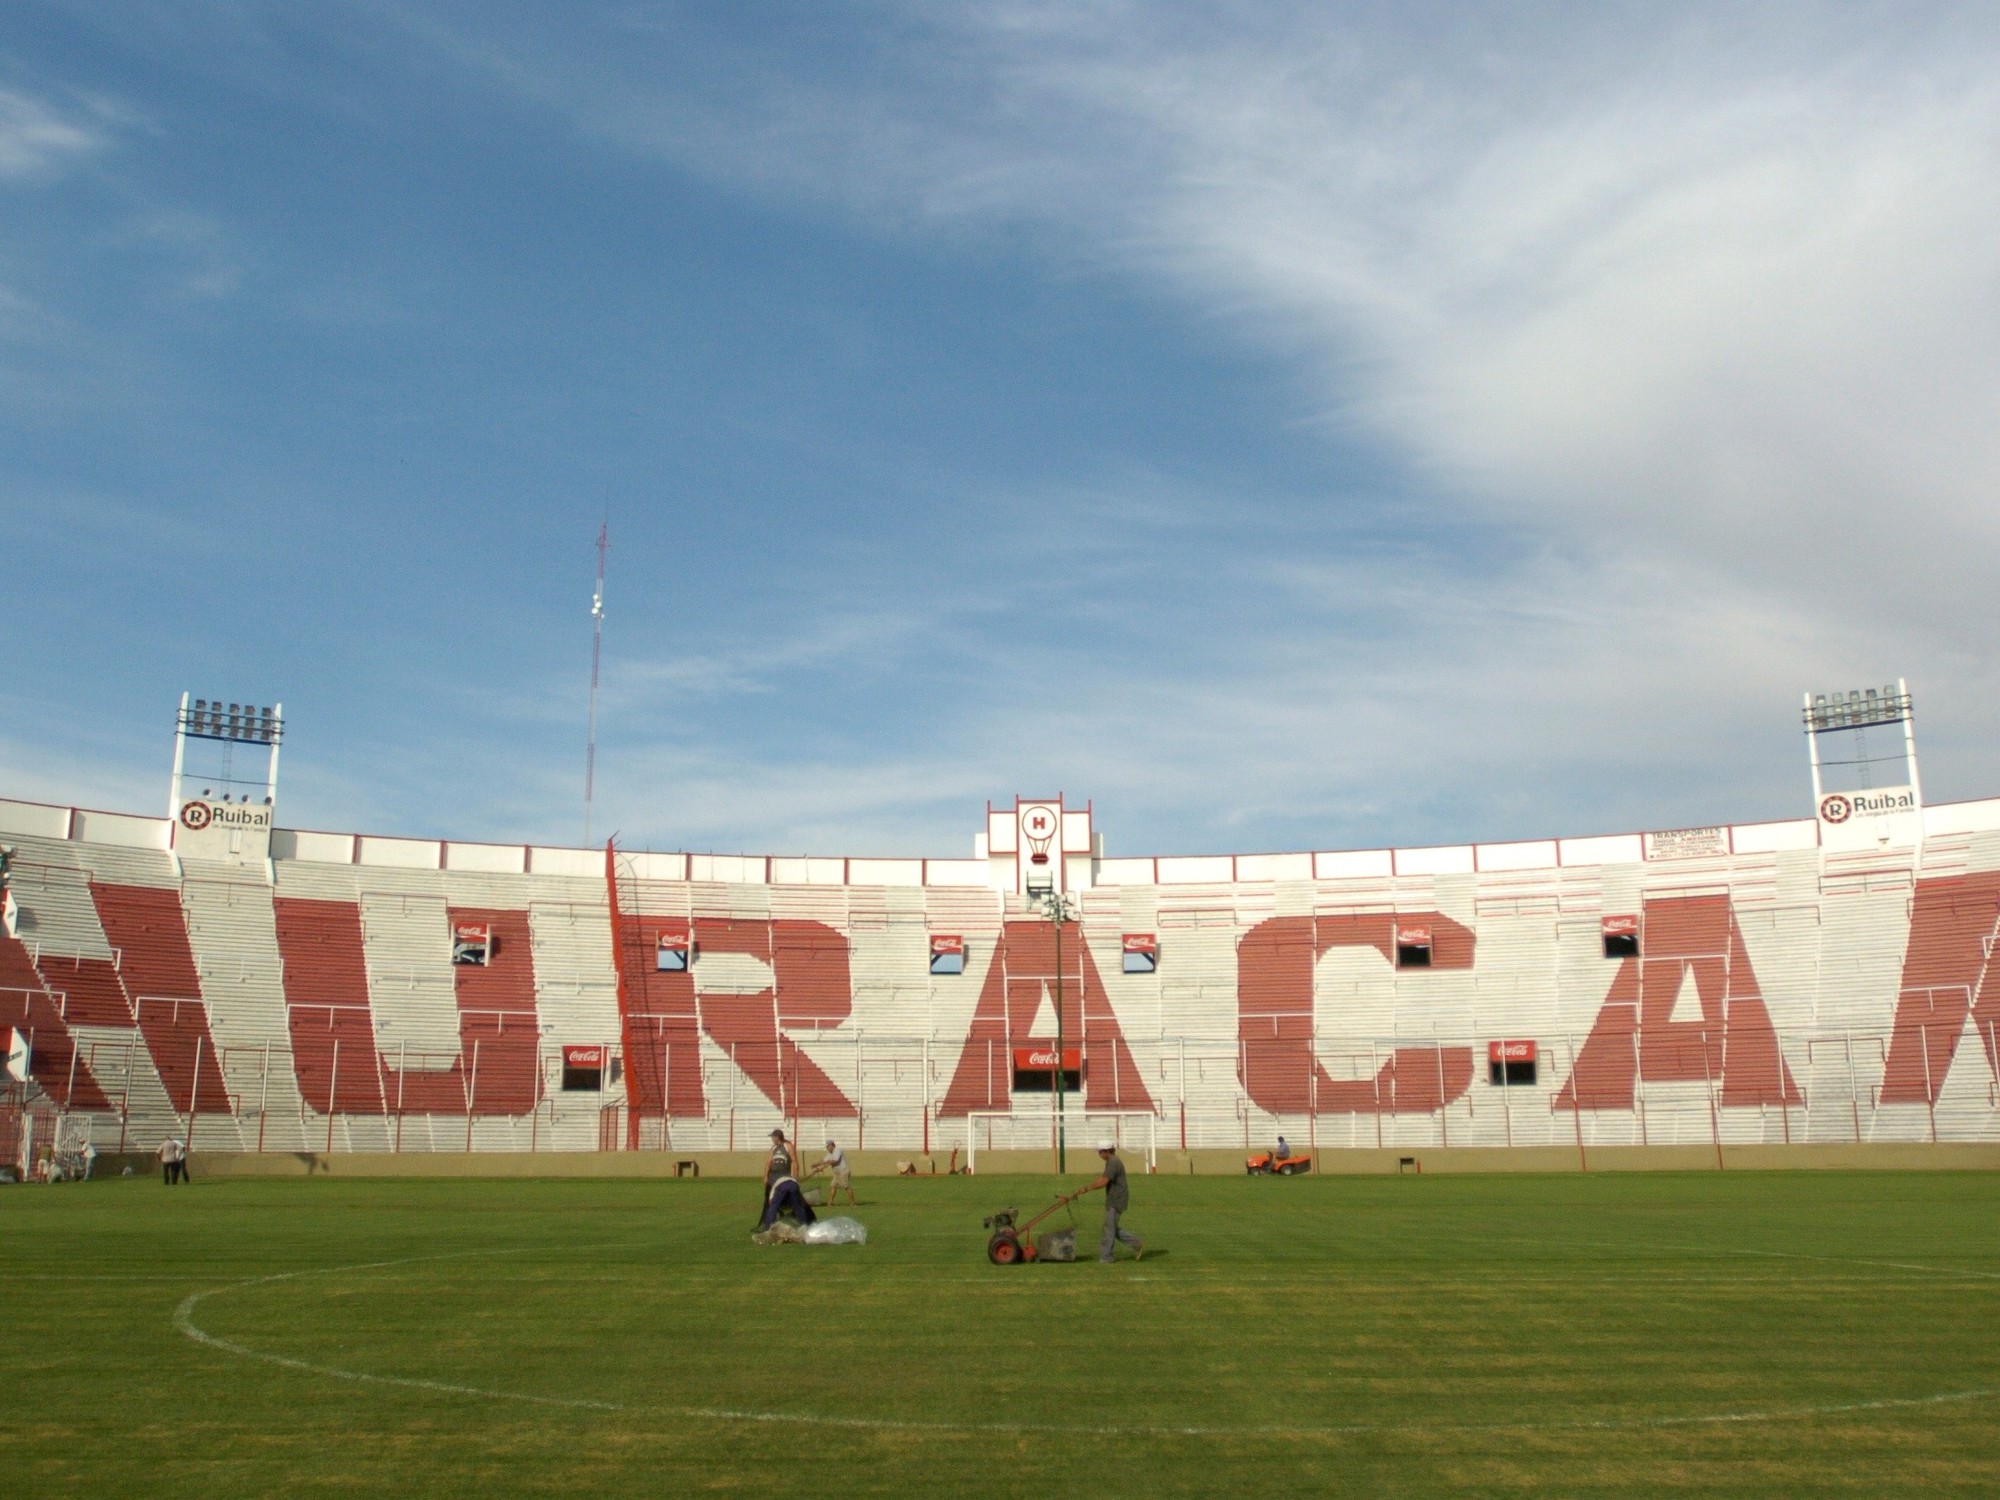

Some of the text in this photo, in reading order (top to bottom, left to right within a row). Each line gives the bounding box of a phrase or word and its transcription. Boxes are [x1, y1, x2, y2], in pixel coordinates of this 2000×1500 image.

[1829, 791, 1914, 816] R Ruibal
[190, 807, 269, 826] R Ruibal
[1032, 816, 1046, 830] H
[1653, 826, 1722, 839] TRANSPORTES
